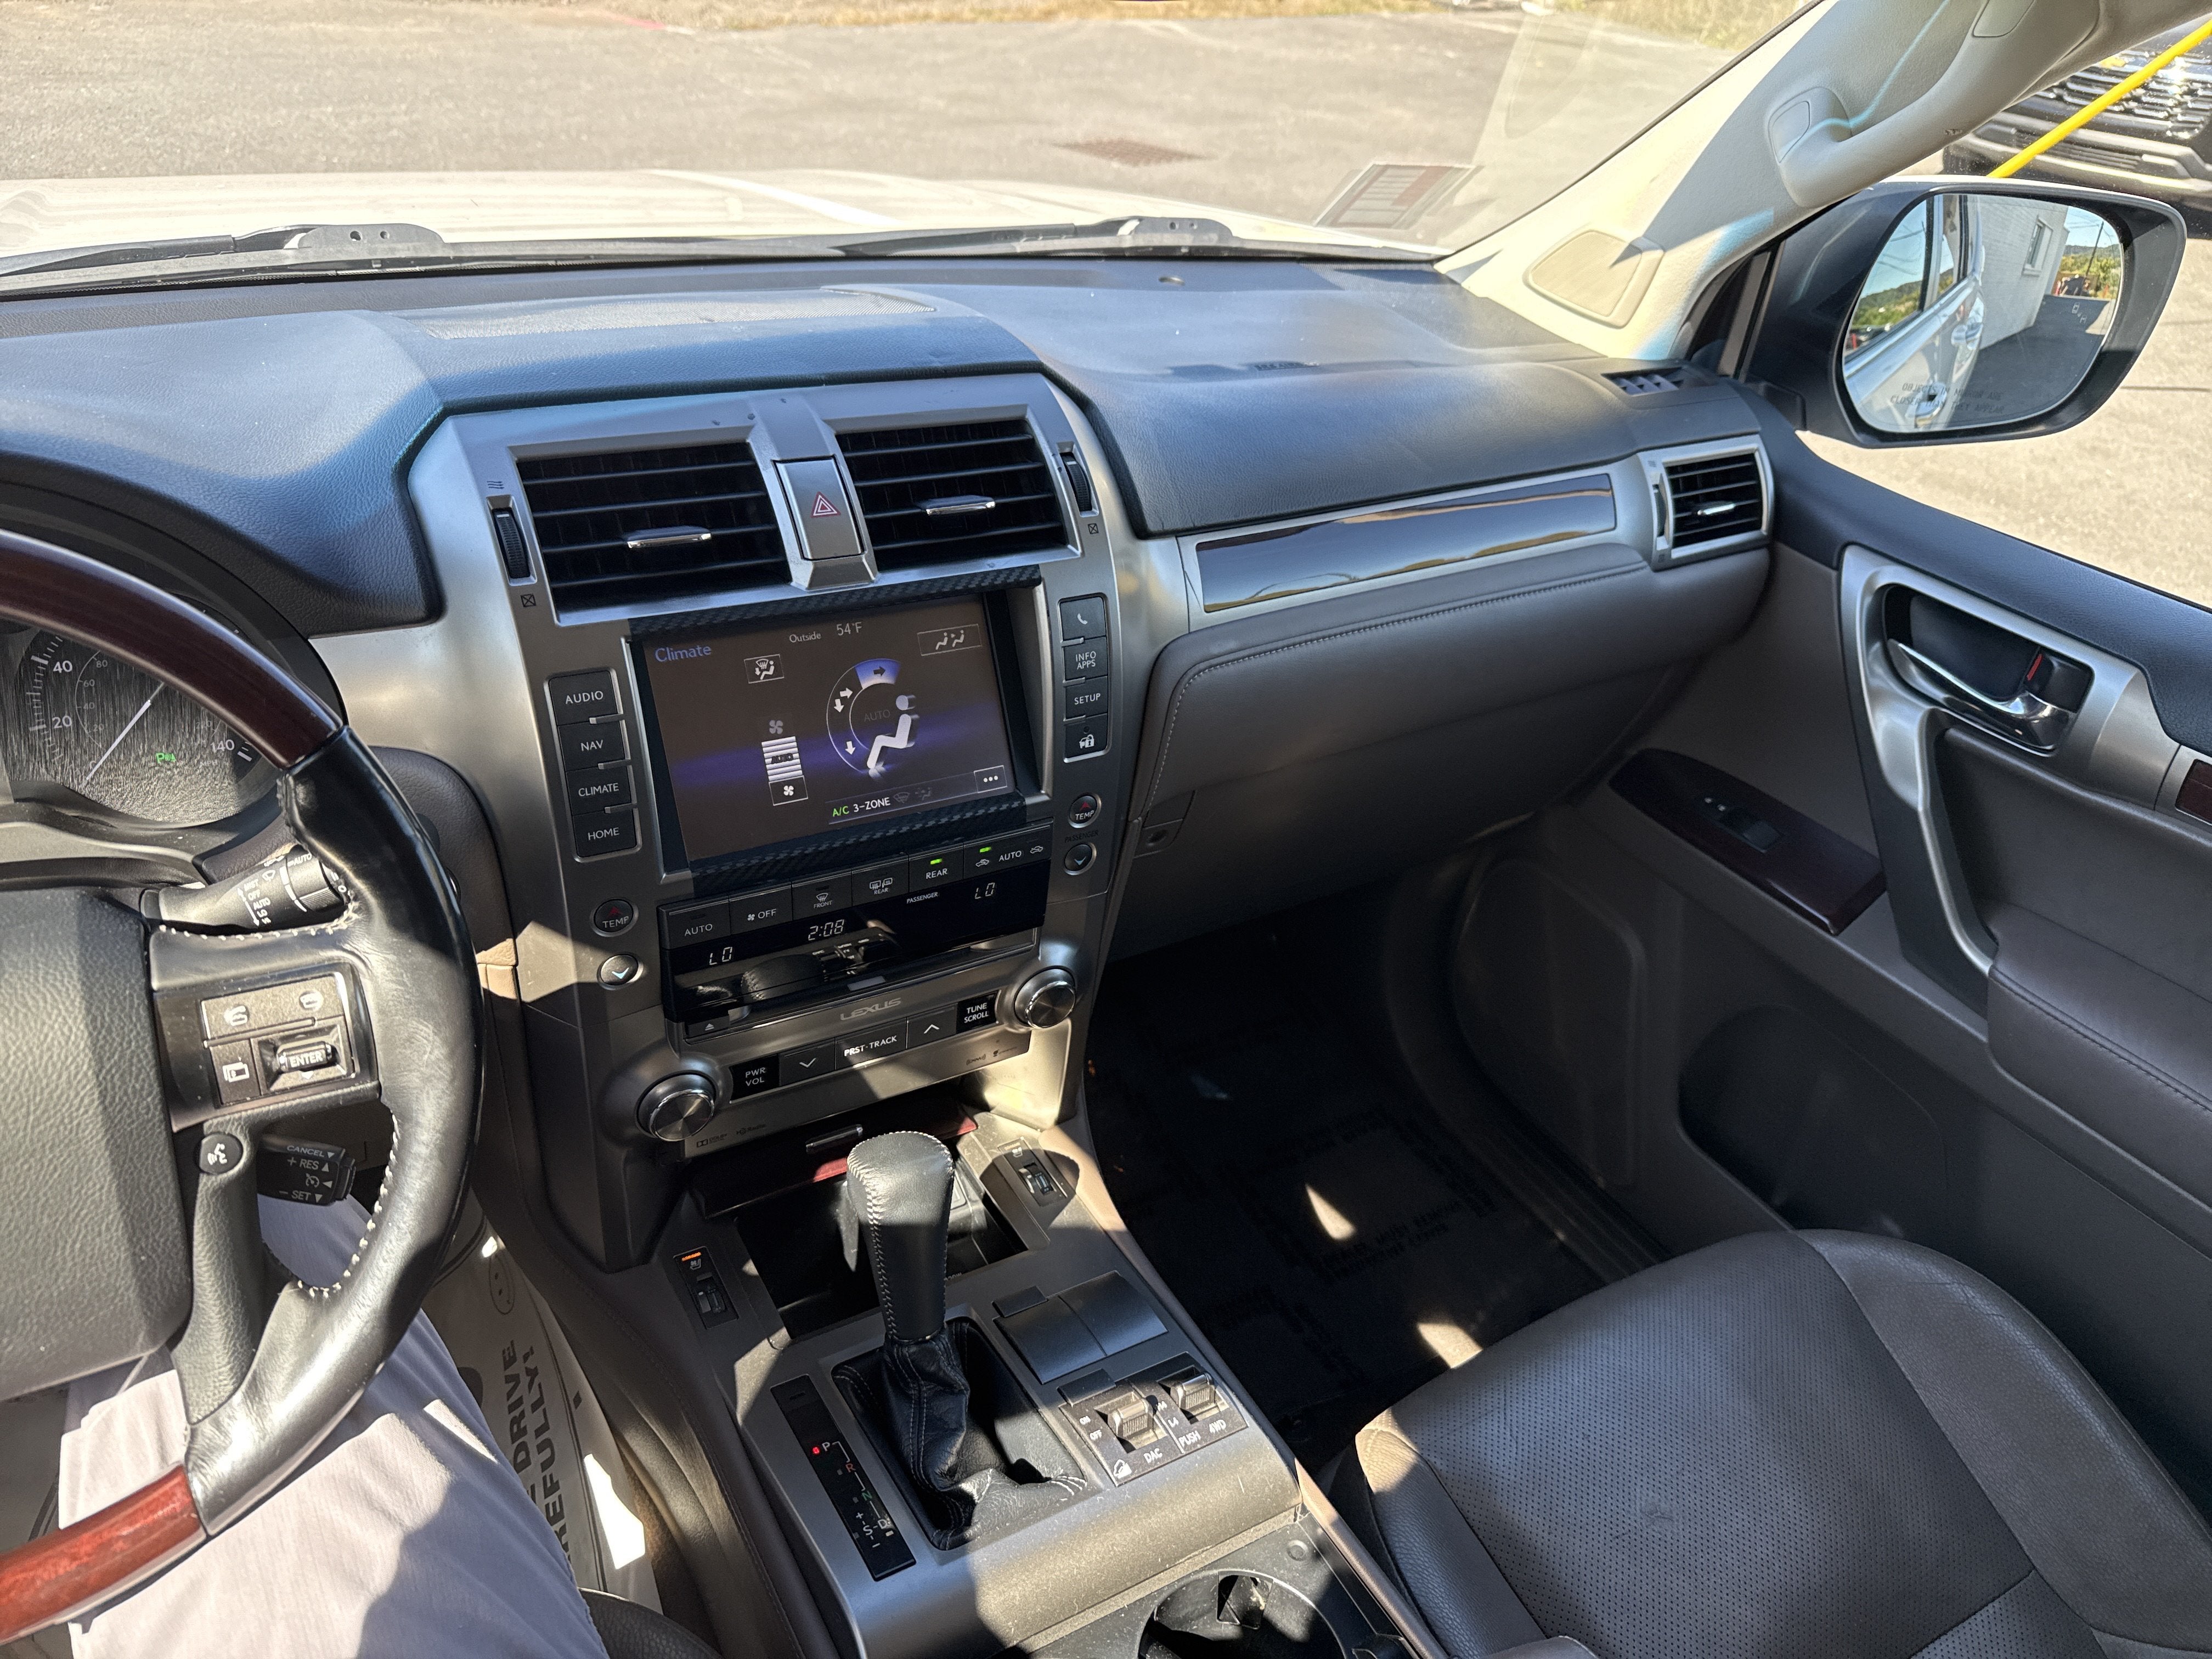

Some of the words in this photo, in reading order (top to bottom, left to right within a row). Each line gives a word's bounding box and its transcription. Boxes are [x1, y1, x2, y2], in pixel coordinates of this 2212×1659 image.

[788, 631, 822, 644] Outside
[654, 642, 712, 664] Climate
[1075, 651, 1096, 662] INFO
[53, 660, 73, 674] 40
[95, 660, 108, 668] 80
[1076, 660, 1096, 670] APPS
[83, 679, 95, 687] 60
[565, 690, 604, 704] AUDIO
[1074, 692, 1101, 706] SETUP
[82, 702, 95, 710] 40
[52, 715, 72, 729] 20
[863, 708, 891, 723] AUTO
[210, 739, 235, 753] 140
[580, 740, 604, 752] NAV
[578, 782, 619, 797] CLIMATE
[832, 805, 850, 817] A/C
[853, 796, 891, 813] 3-ZONE
[1075, 810, 1094, 821] TEMP
[588, 827, 620, 840] HOME
[1064, 830, 1098, 843] PASSENGER
[293, 853, 312, 866] AUTO
[998, 850, 1022, 862] AUTO
[926, 867, 948, 880] REAR
[253, 897, 271, 911] AUTO
[906, 891, 939, 904] PASSENGER
[813, 900, 833, 909] FRONT
[758, 908, 777, 919] OFF
[602, 916, 629, 929] TEMP
[684, 923, 713, 936] AUTO
[808, 919, 845, 941] 2:08
[840, 997, 901, 1021] LEXUS
[967, 1002, 988, 1014] TUNE
[963, 1010, 989, 1024] SCROLL
[290, 1051, 323, 1068] ENTER
[745, 1067, 766, 1078] PWR
[745, 1076, 765, 1087] VOL
[286, 1145, 324, 1158] CANCEL
[300, 1159, 319, 1170] RES
[291, 1189, 309, 1201] SET
[502, 1339, 532, 1475] DRIVE
[1079, 1415, 1091, 1425] ON
[1208, 1419, 1227, 1434] 4WD
[1090, 1429, 1102, 1441] OFF
[1178, 1430, 1201, 1448] PUSH
[821, 1441, 831, 1452] P
[523, 1345, 571, 1564] REFULLY!
[1143, 1448, 1163, 1464] DAC
[845, 1463, 856, 1473] R
[861, 1491, 873, 1501] N
[862, 1525, 873, 1536] S
[878, 1518, 888, 1530] D
